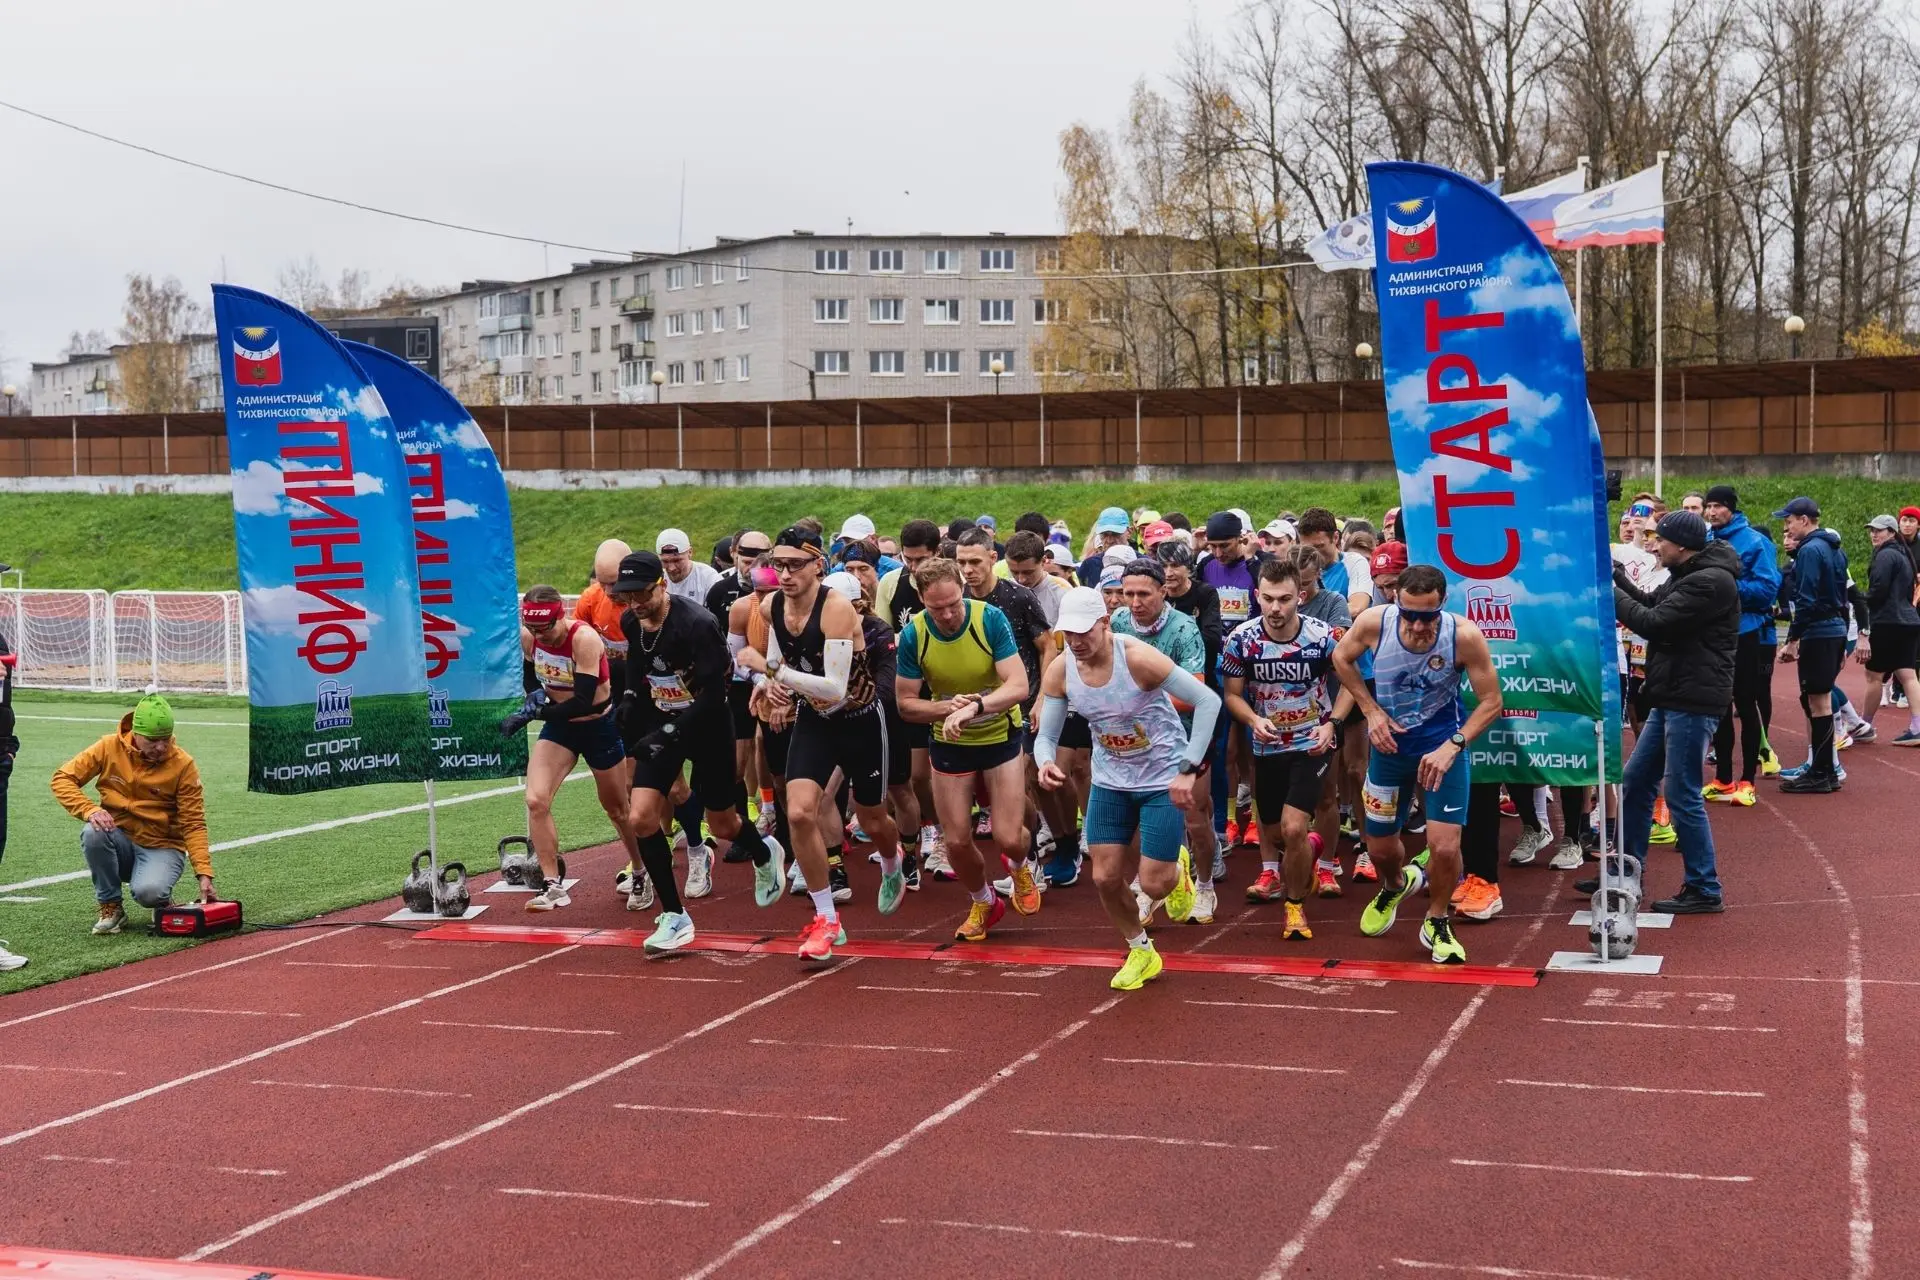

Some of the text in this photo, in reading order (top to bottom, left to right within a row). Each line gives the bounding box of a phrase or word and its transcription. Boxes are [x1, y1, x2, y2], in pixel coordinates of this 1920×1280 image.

[1388, 262, 1484, 284] АДМИНИСТРАЦИЯ
[1388, 275, 1513, 297] ТИХВИНСКОГО РАЙОНА
[235, 394, 323, 407] АДМИНИСТРАЦИЯ
[237, 406, 348, 419] ТИХВИНСКОГО РАЙОНА
[1424, 299, 1522, 581] СТАРТ
[277, 421, 369, 675] ФИНИШ
[1484, 629, 1514, 639] ХВИН
[1489, 653, 1532, 669] ОРТ
[1253, 661, 1312, 681] RUSSIA
[1500, 676, 1579, 696] ЖИЗНИ
[317, 718, 351, 729] ТИХВИН
[305, 737, 361, 757] СПОРТ
[431, 736, 463, 750] ОРТ
[1488, 730, 1549, 746] СПОРТ
[263, 753, 400, 780] НОРМА ЖИЗНИ
[439, 753, 501, 768] ЖИЗНИ
[1469, 751, 1588, 769] РМА ЖИЗНИ
